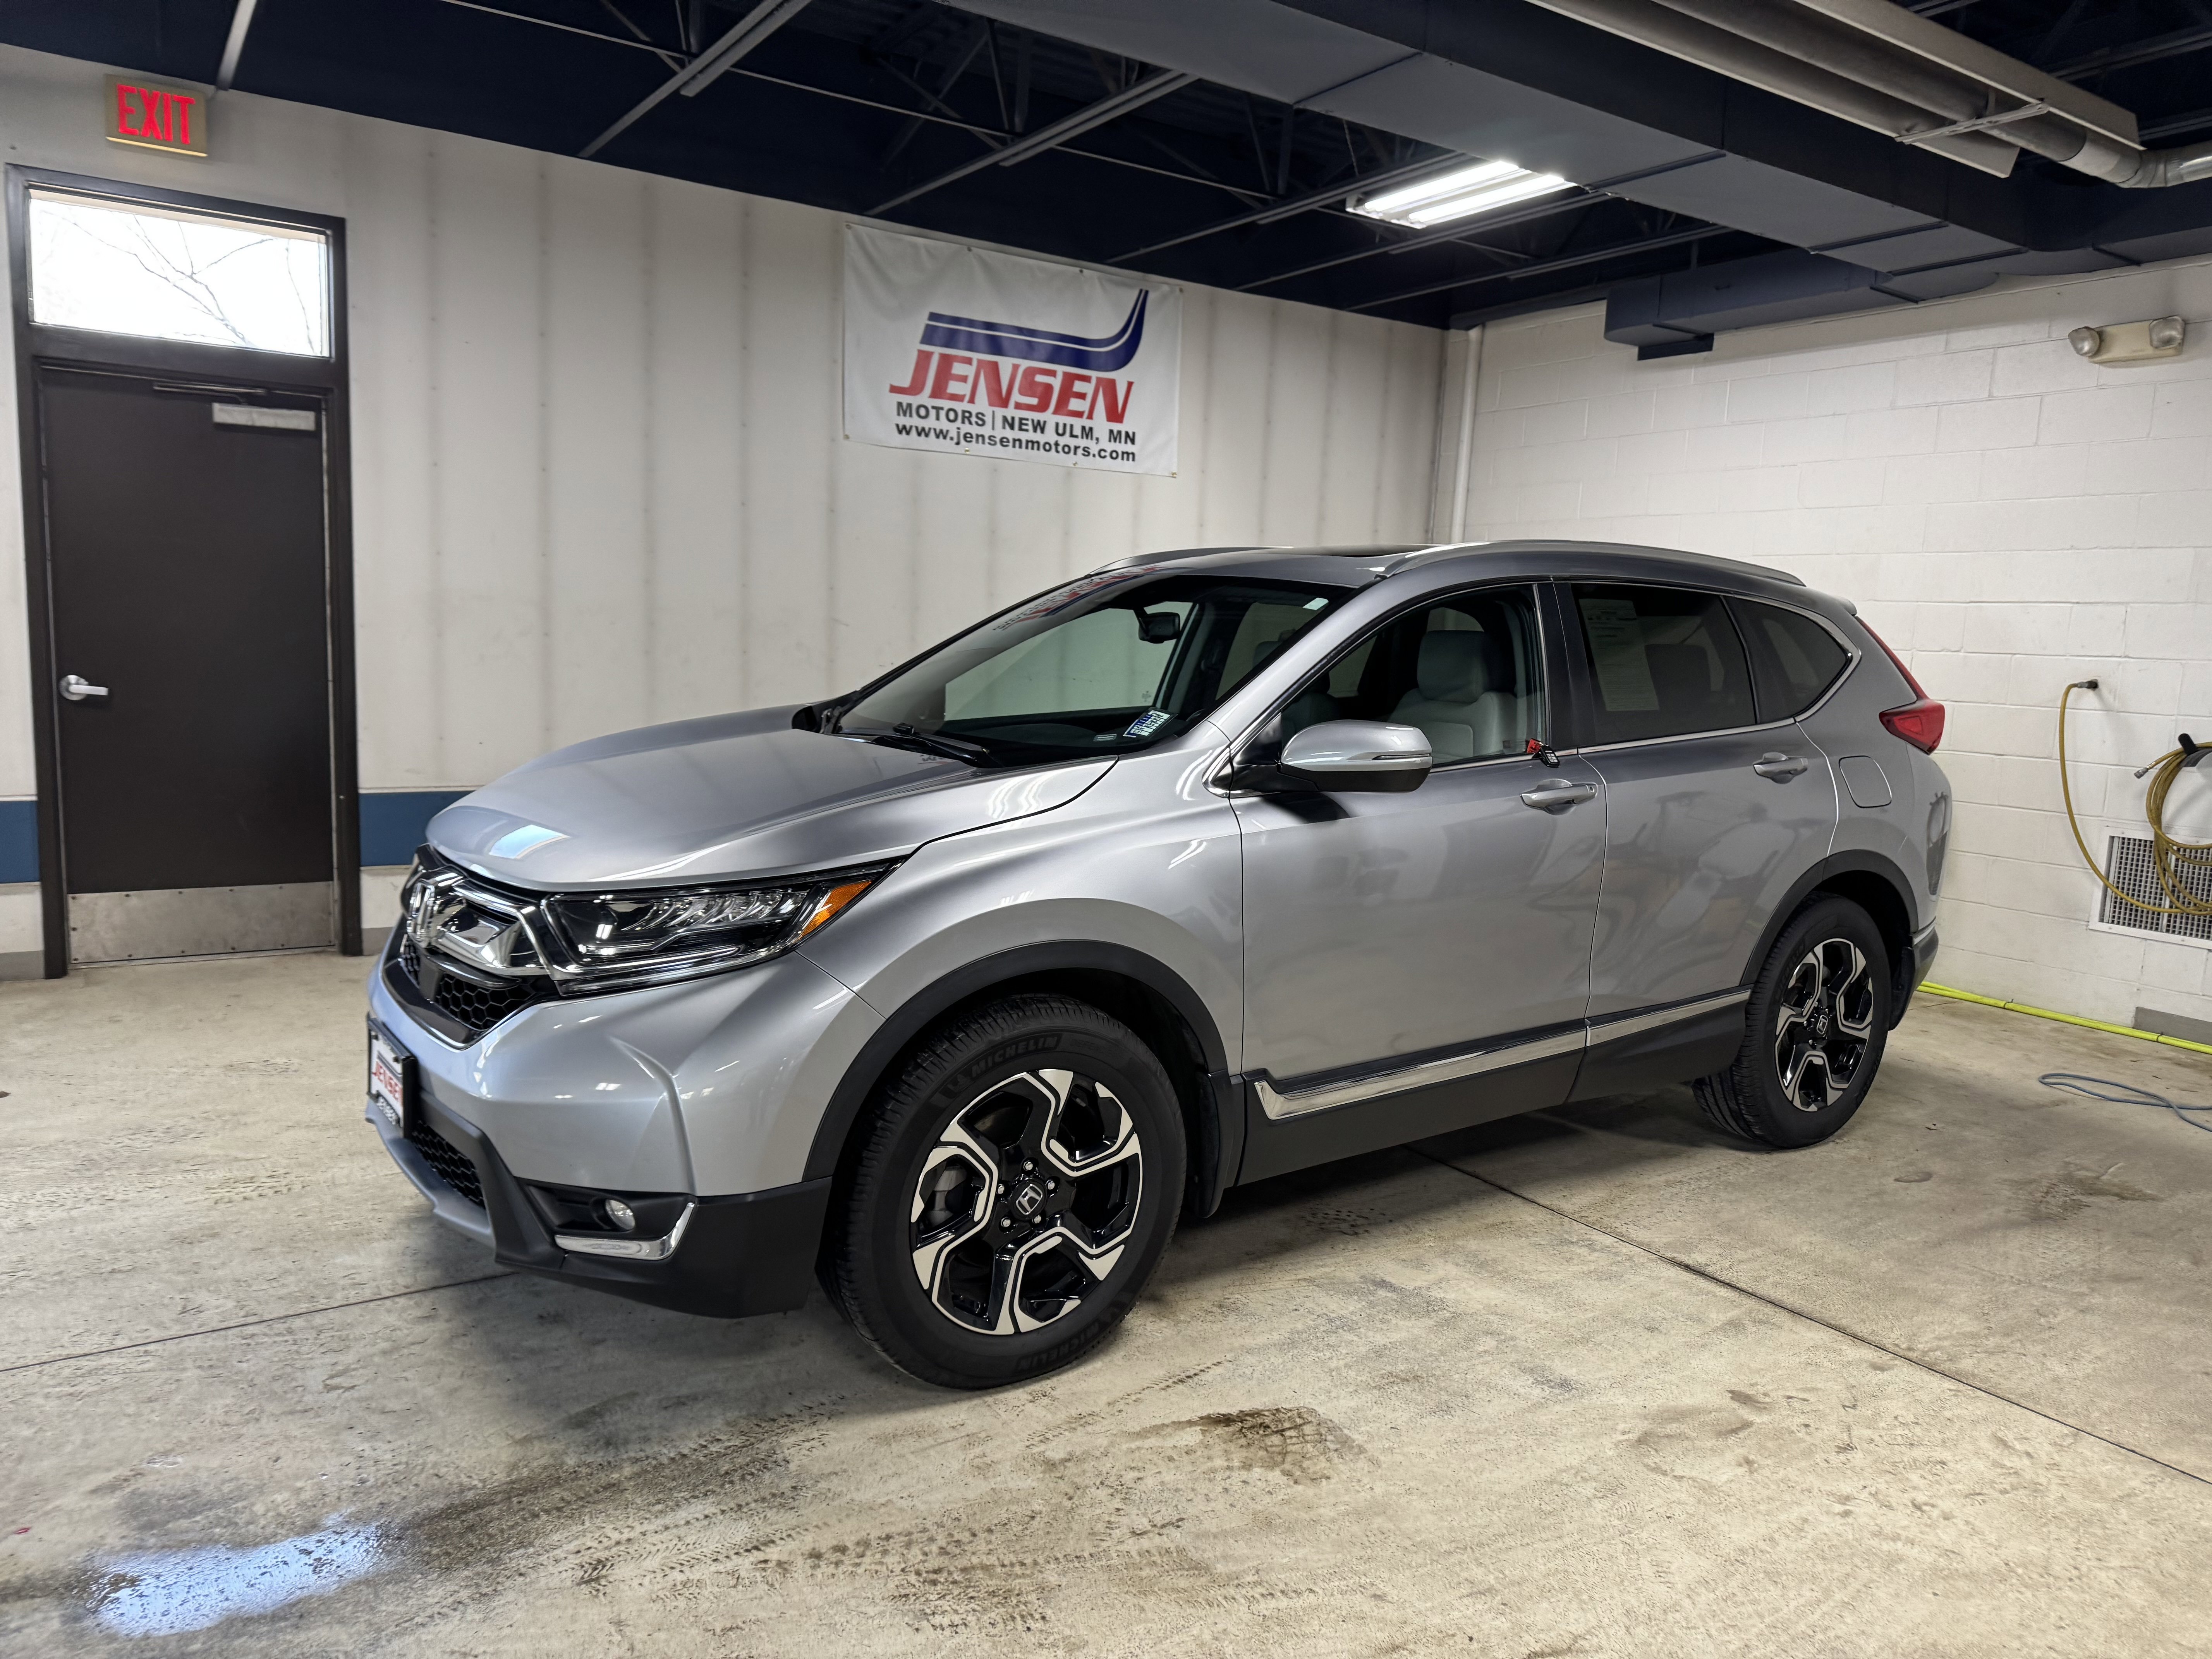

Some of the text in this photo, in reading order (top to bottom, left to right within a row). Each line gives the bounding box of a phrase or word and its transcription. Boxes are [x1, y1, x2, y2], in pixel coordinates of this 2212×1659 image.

[117, 84, 196, 145] EXIT
[889, 350, 1134, 424] JENSEN
[895, 423, 1135, 462] www.jensenmotors.com
[897, 401, 1135, 445] MOTORS NEW ULM, MN
[971, 1036, 1058, 1079] MICHELIN
